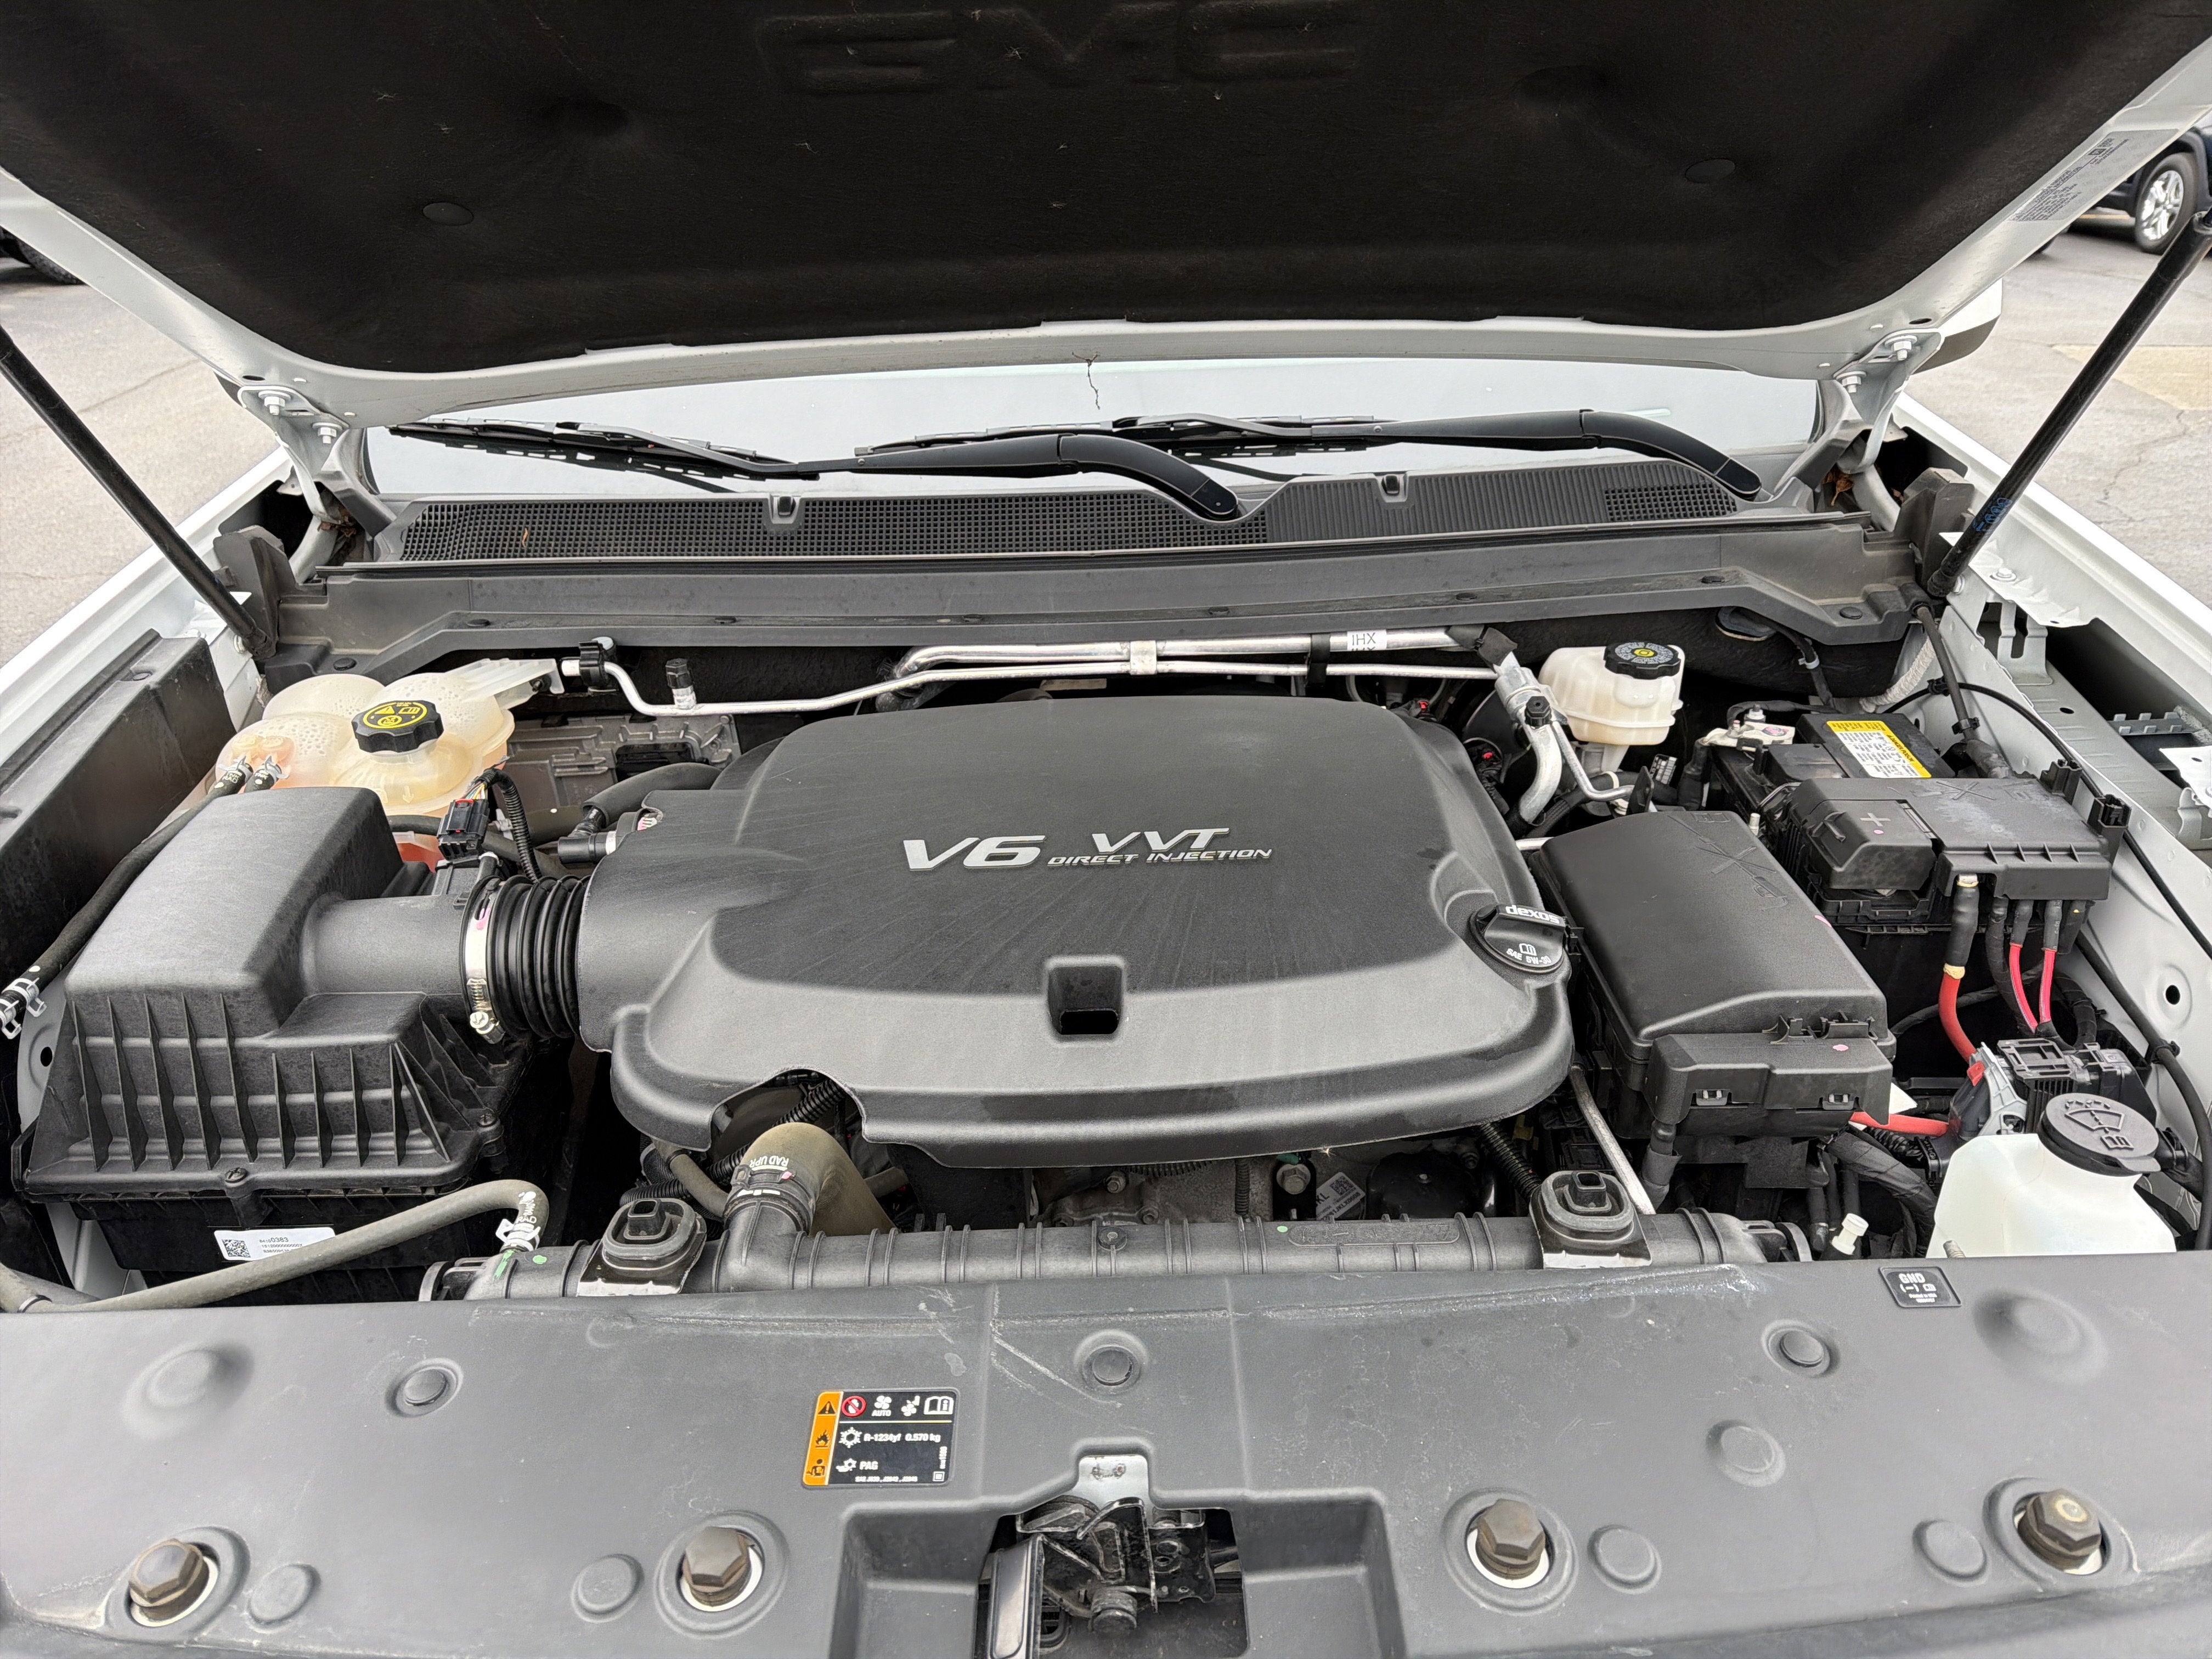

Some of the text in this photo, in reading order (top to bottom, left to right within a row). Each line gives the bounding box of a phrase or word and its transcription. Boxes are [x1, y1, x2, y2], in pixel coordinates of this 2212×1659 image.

[1092, 827, 1230, 854] VVT
[903, 835, 1046, 871] V6
[1047, 849, 1273, 866] DIRECT INJECTION
[1505, 905, 1560, 924] dexos
[1506, 948, 1552, 964] SAE 5W-30
[749, 1155, 789, 1168] RAD UPR
[516, 1216, 537, 1224] RAD
[1898, 1273, 1926, 1284] GND
[864, 1433, 941, 1443] R-1234yf 0.570 kg
[859, 1460, 878, 1470] PAG
